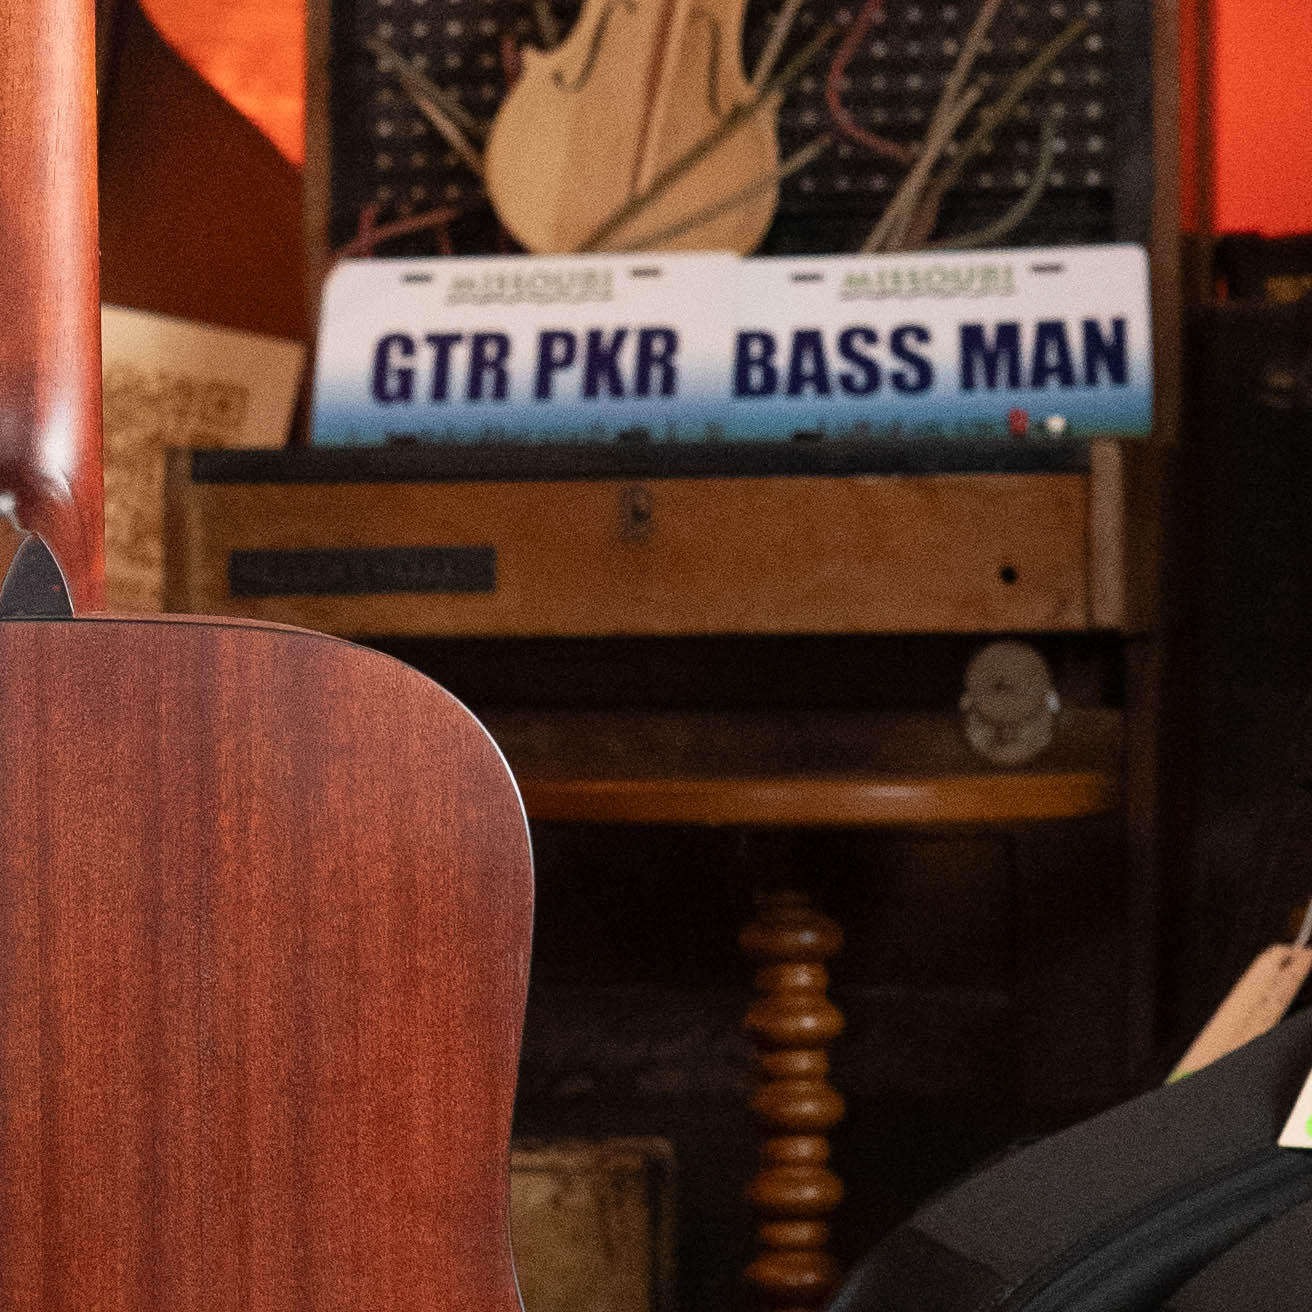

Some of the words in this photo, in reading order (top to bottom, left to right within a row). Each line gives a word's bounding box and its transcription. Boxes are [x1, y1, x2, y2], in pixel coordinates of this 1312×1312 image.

[371, 329, 513, 405] GTR
[533, 325, 680, 402] PKR
[733, 322, 934, 399] BASS
[958, 316, 1129, 392] MAN
